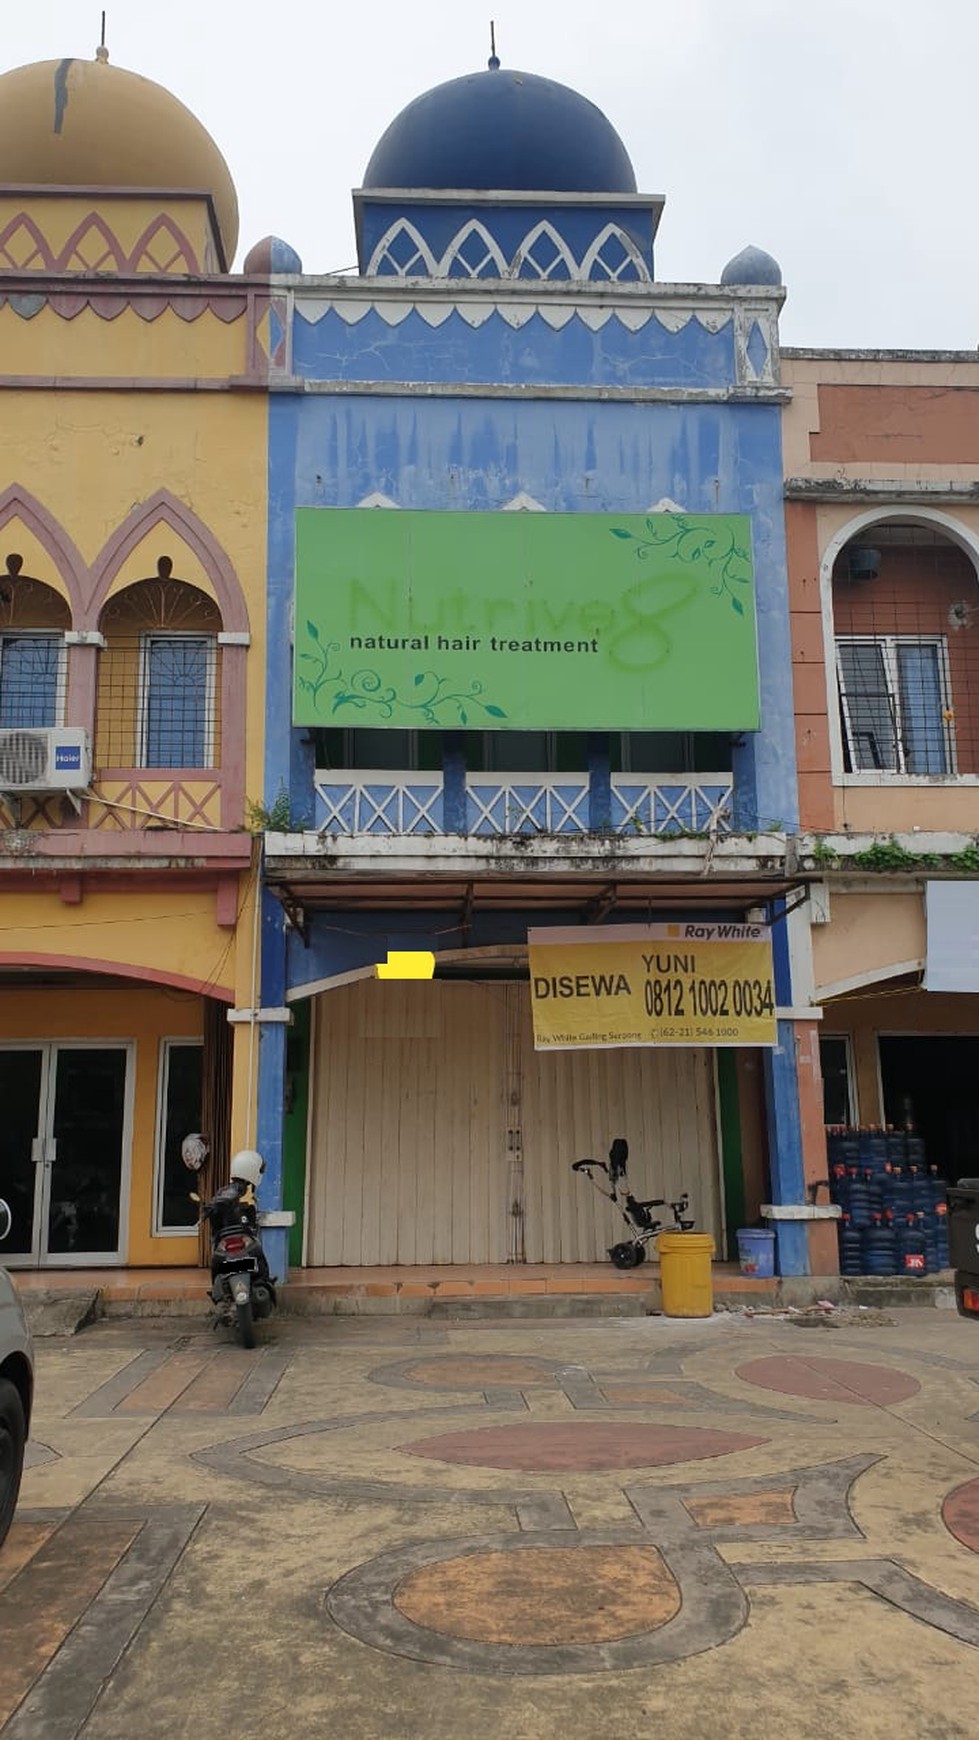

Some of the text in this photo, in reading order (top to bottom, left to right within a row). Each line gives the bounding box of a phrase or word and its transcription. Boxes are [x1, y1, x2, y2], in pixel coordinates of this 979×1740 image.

[349, 635, 599, 653] natural hair treatment
[684, 924, 761, 940] Ray White
[641, 954, 695, 974] YUNI
[534, 975, 631, 999] DISEWA
[644, 978, 774, 1017] 0812 1002 0034
